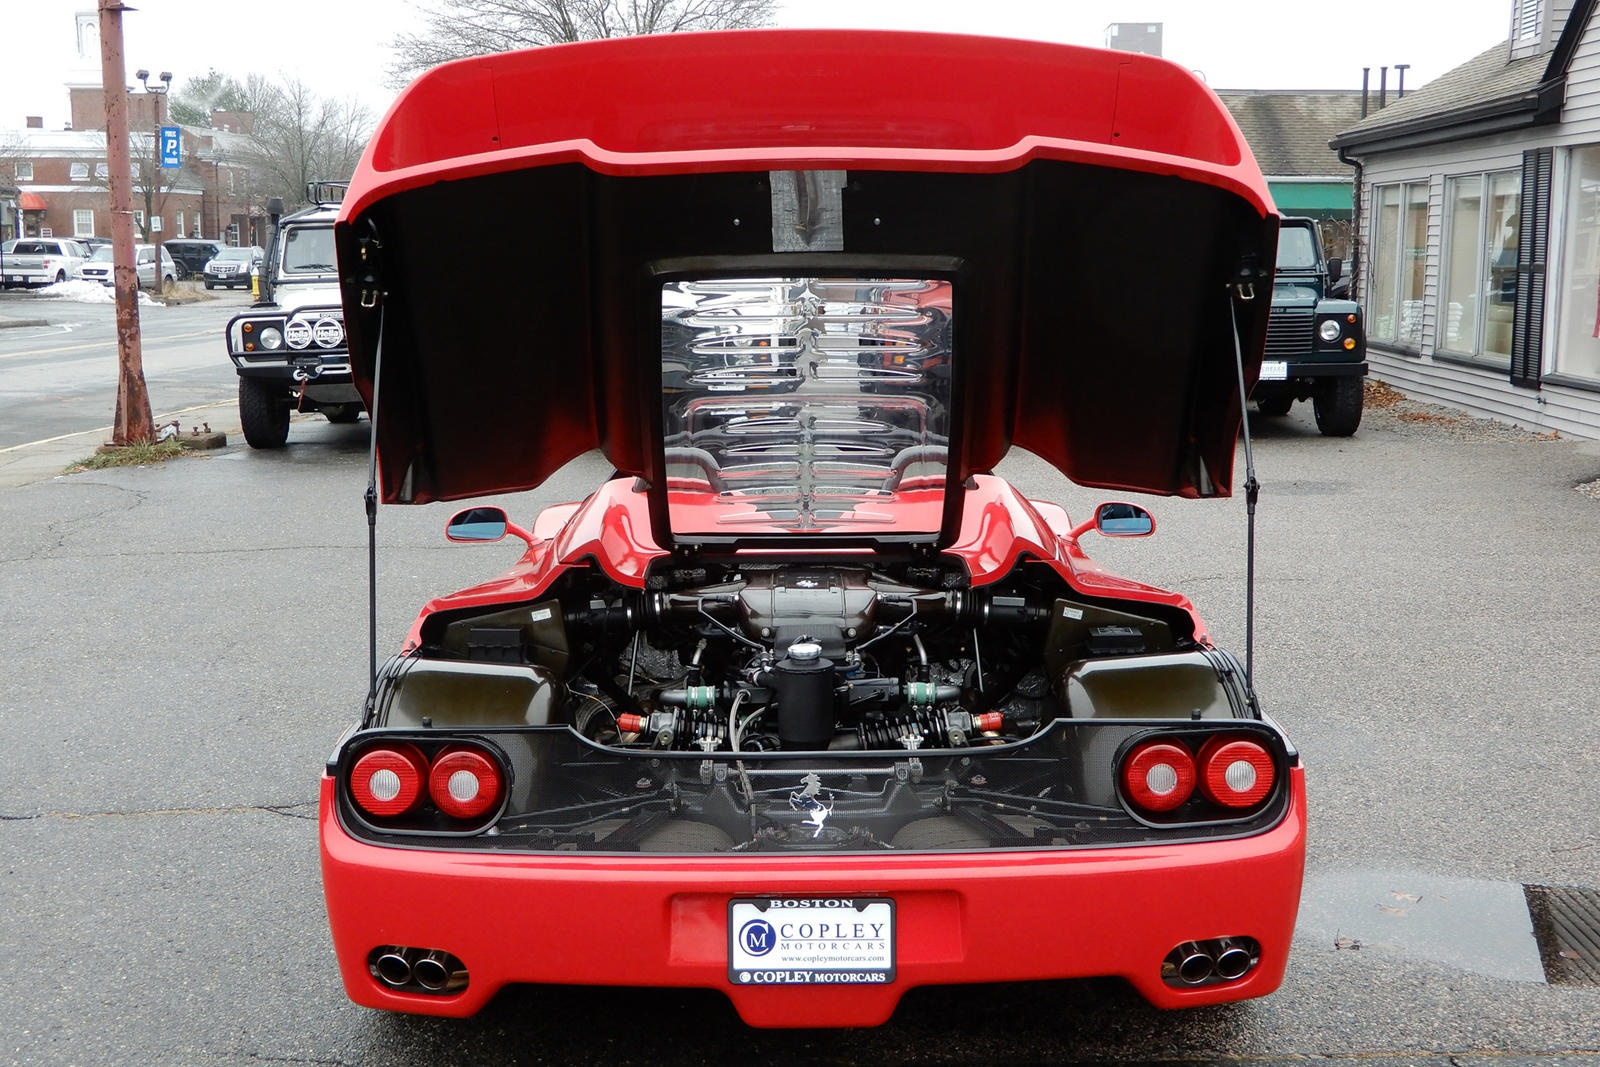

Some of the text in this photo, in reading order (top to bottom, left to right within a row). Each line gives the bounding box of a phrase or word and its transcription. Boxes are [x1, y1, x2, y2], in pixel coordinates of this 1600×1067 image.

[166, 139, 178, 154] P
[769, 899, 854, 908] BOSTON
[780, 923, 884, 938] COPLEY
[780, 942, 885, 950] MOTORCARS
[781, 954, 885, 964] www.copleymotorcars.com
[753, 971, 813, 983] COPLEY
[814, 972, 886, 983] MOTORCARS
